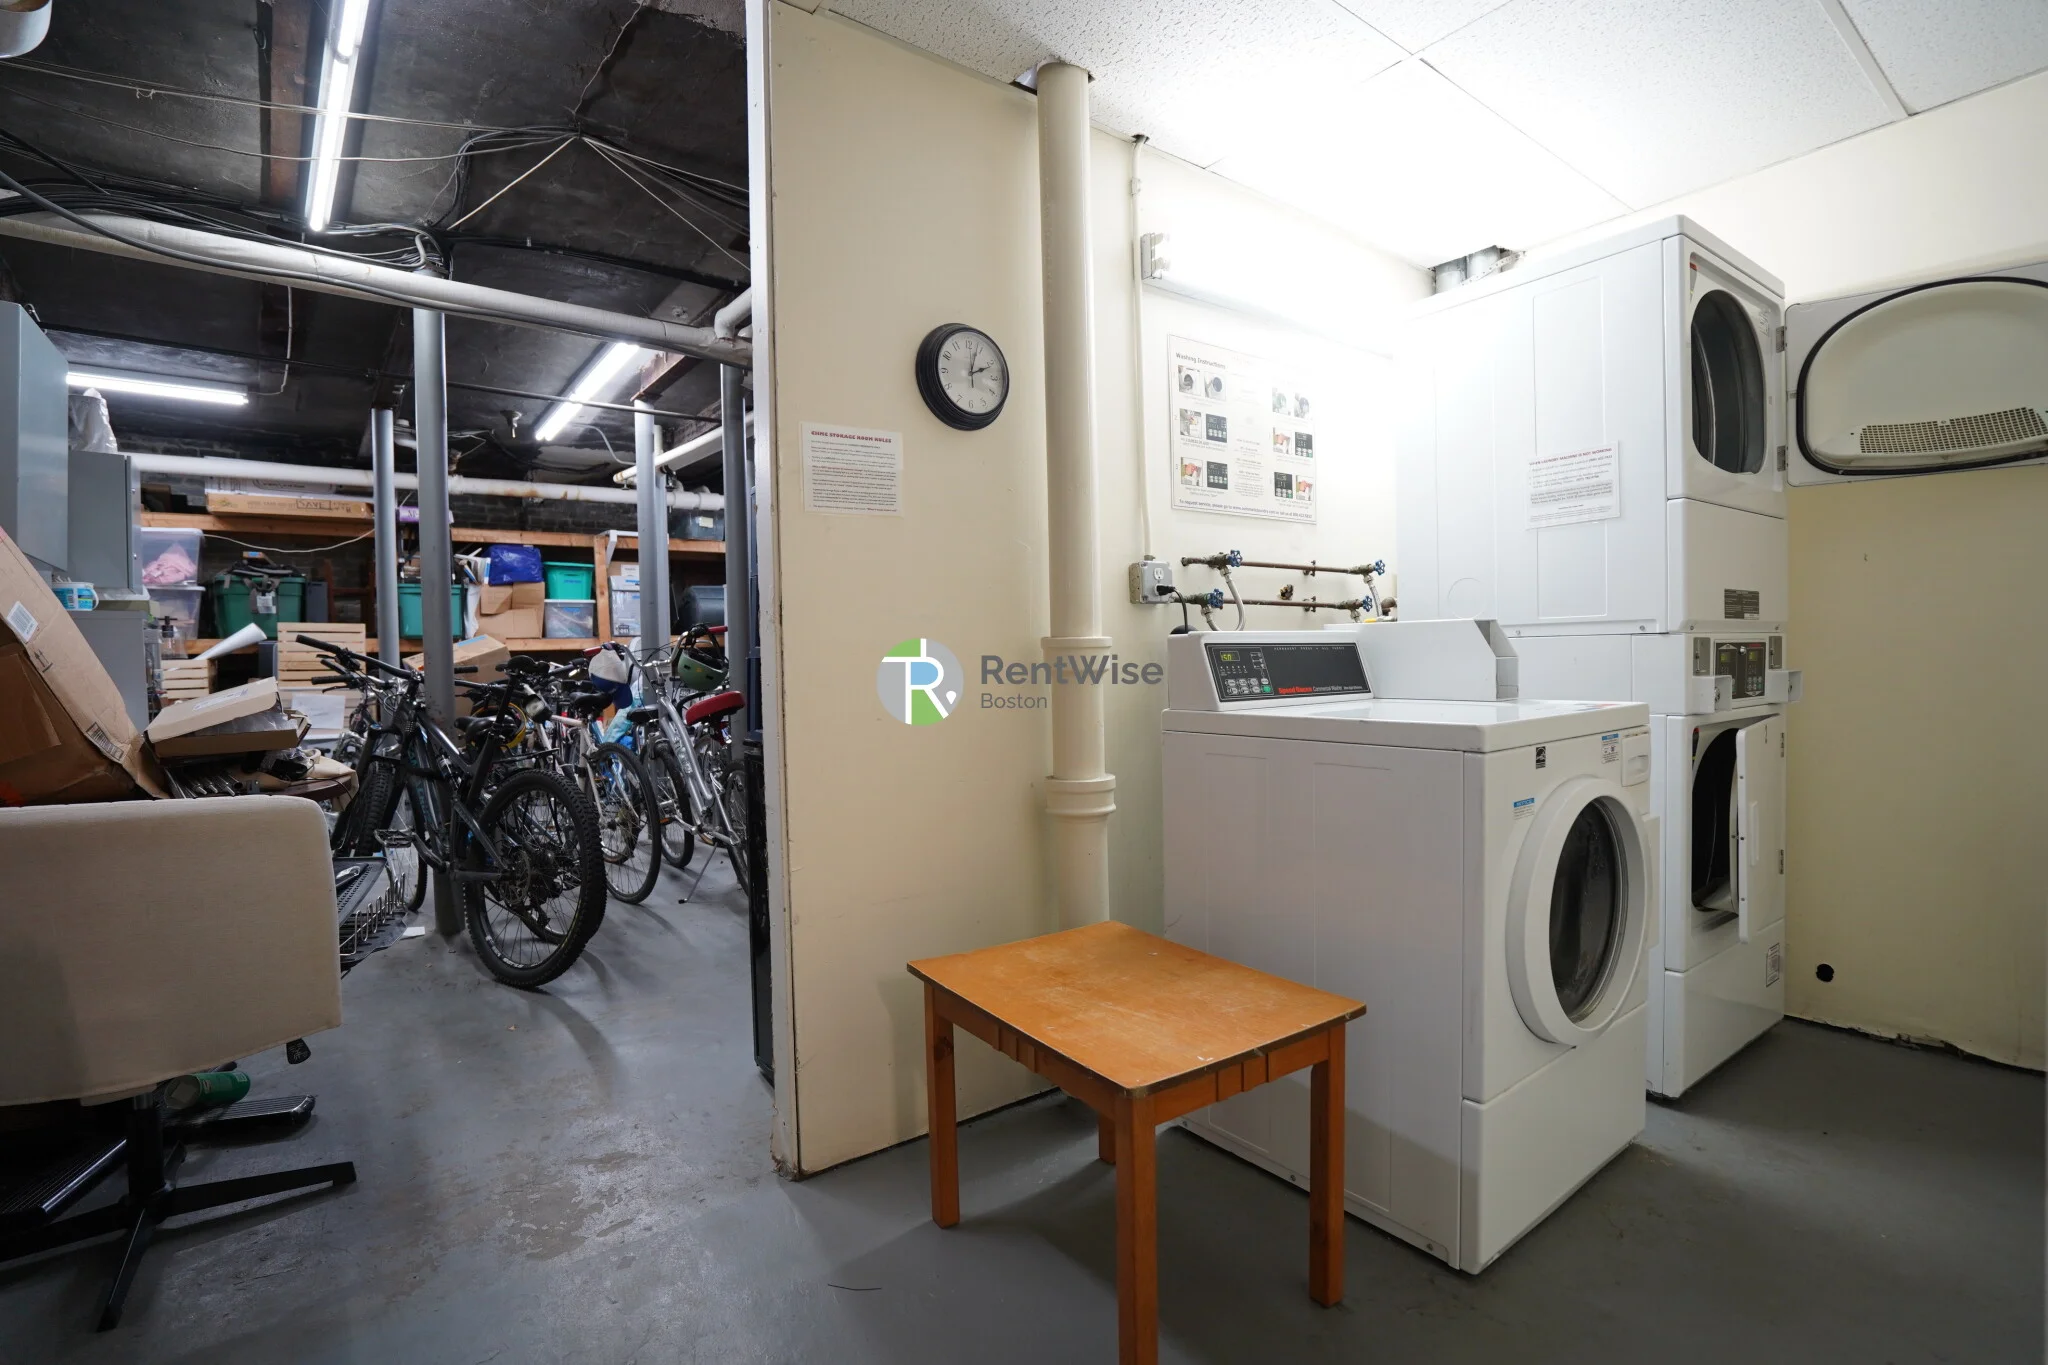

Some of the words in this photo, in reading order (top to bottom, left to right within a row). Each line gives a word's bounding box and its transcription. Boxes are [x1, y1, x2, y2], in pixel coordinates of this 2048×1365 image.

[952, 341, 960, 351] 11
[965, 340, 972, 349] 12
[943, 351, 951, 360] 10
[987, 359, 994, 367] 2
[1176, 352, 1197, 363] Washing
[1197, 357, 1226, 369] Instructions
[957, 395, 963, 403] 7
[980, 398, 987, 406] 5
[969, 400, 974, 408] 6
[298, 500, 326, 509] SAVE
